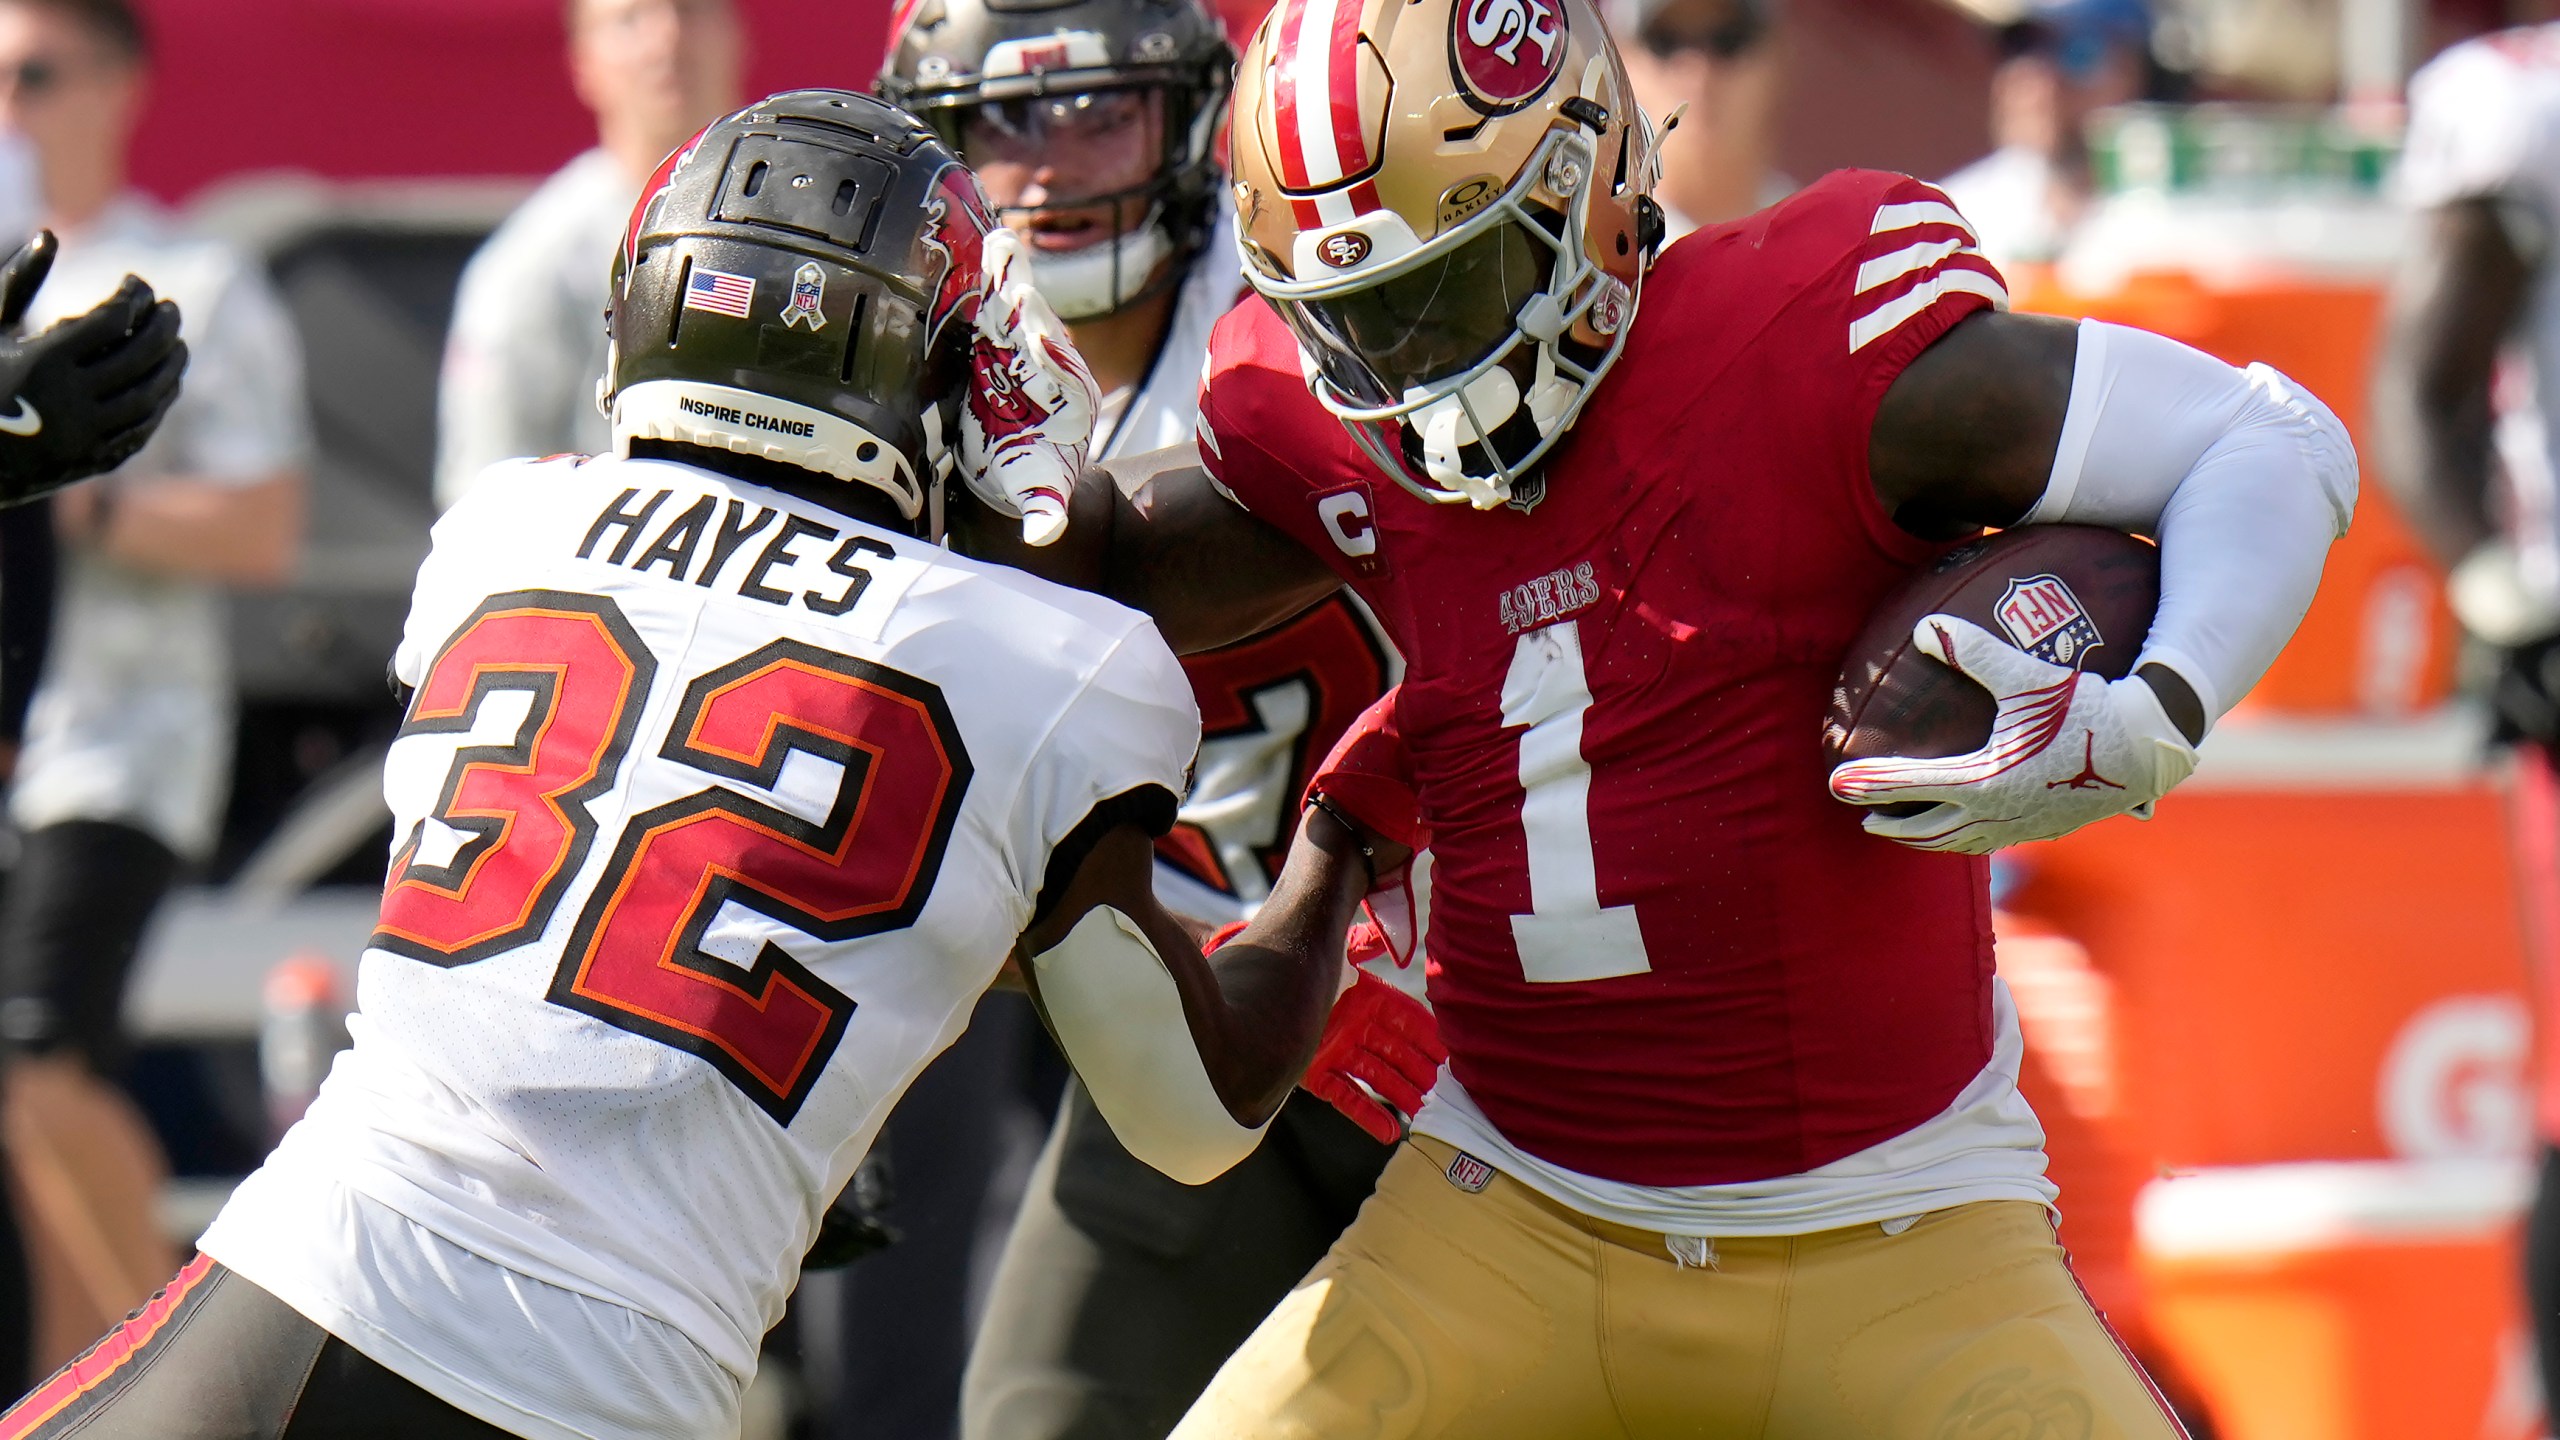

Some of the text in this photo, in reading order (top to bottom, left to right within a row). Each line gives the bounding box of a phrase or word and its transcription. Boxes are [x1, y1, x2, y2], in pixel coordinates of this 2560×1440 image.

[1327, 235, 1362, 265] SF
[795, 293, 816, 309] NFL
[680, 397, 815, 438] INSPIRE CHANGE
[575, 488, 897, 616] HAYES
[1318, 491, 1376, 557] C
[1499, 561, 1600, 635] 49ERS
[2005, 583, 2075, 640] NFL
[1500, 619, 1652, 982] 1
[366, 588, 975, 1129] 32
[2375, 993, 2534, 1164] G
[1453, 1157, 1486, 1185] NFL
